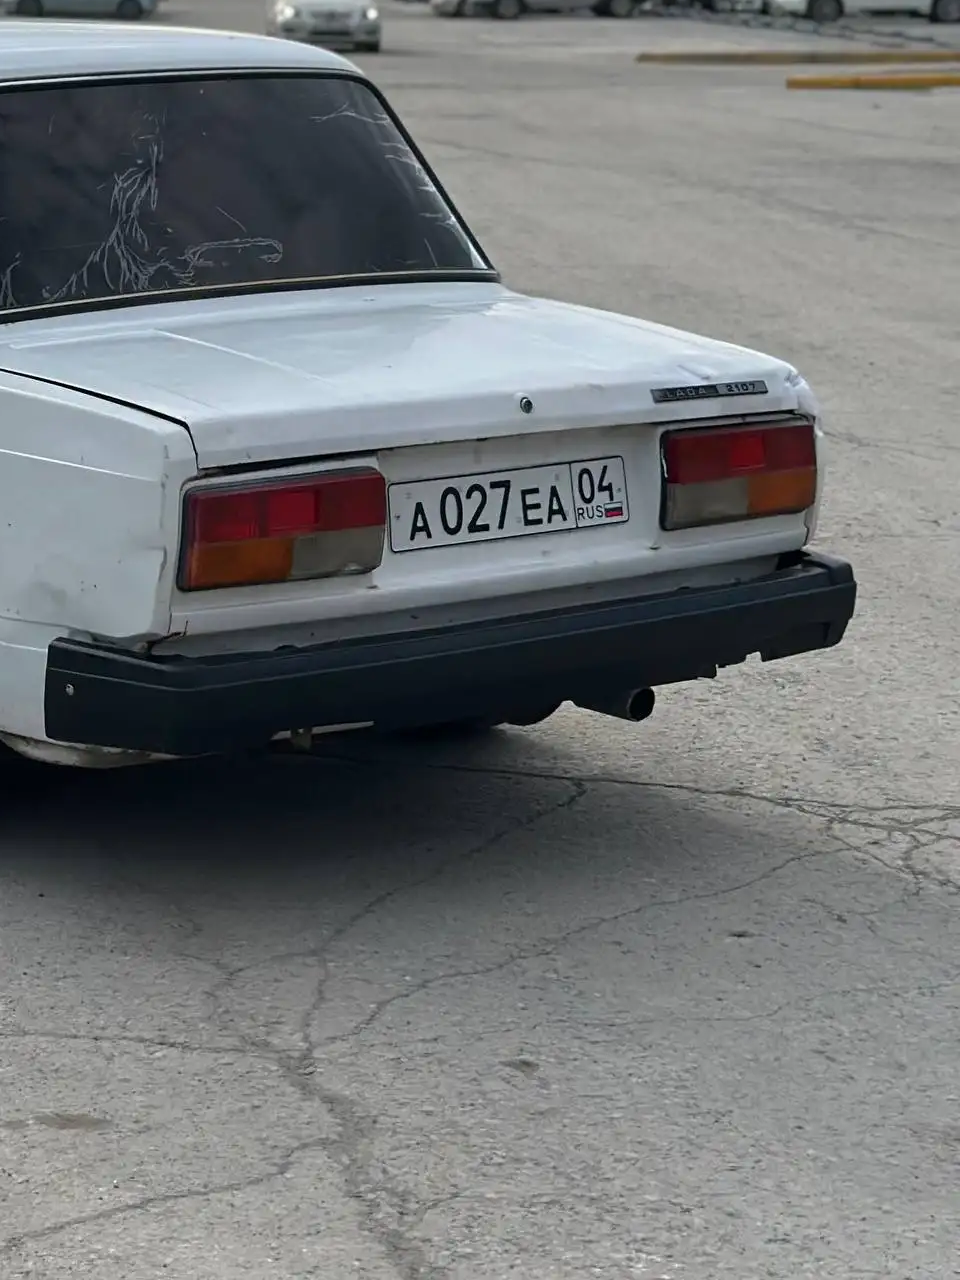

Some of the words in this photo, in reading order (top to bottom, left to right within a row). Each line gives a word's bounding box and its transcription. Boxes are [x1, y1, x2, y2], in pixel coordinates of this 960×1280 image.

[666, 388, 707, 399] LADA
[726, 383, 756, 393] 2107
[578, 465, 614, 505] 04
[577, 505, 604, 521] RUS
